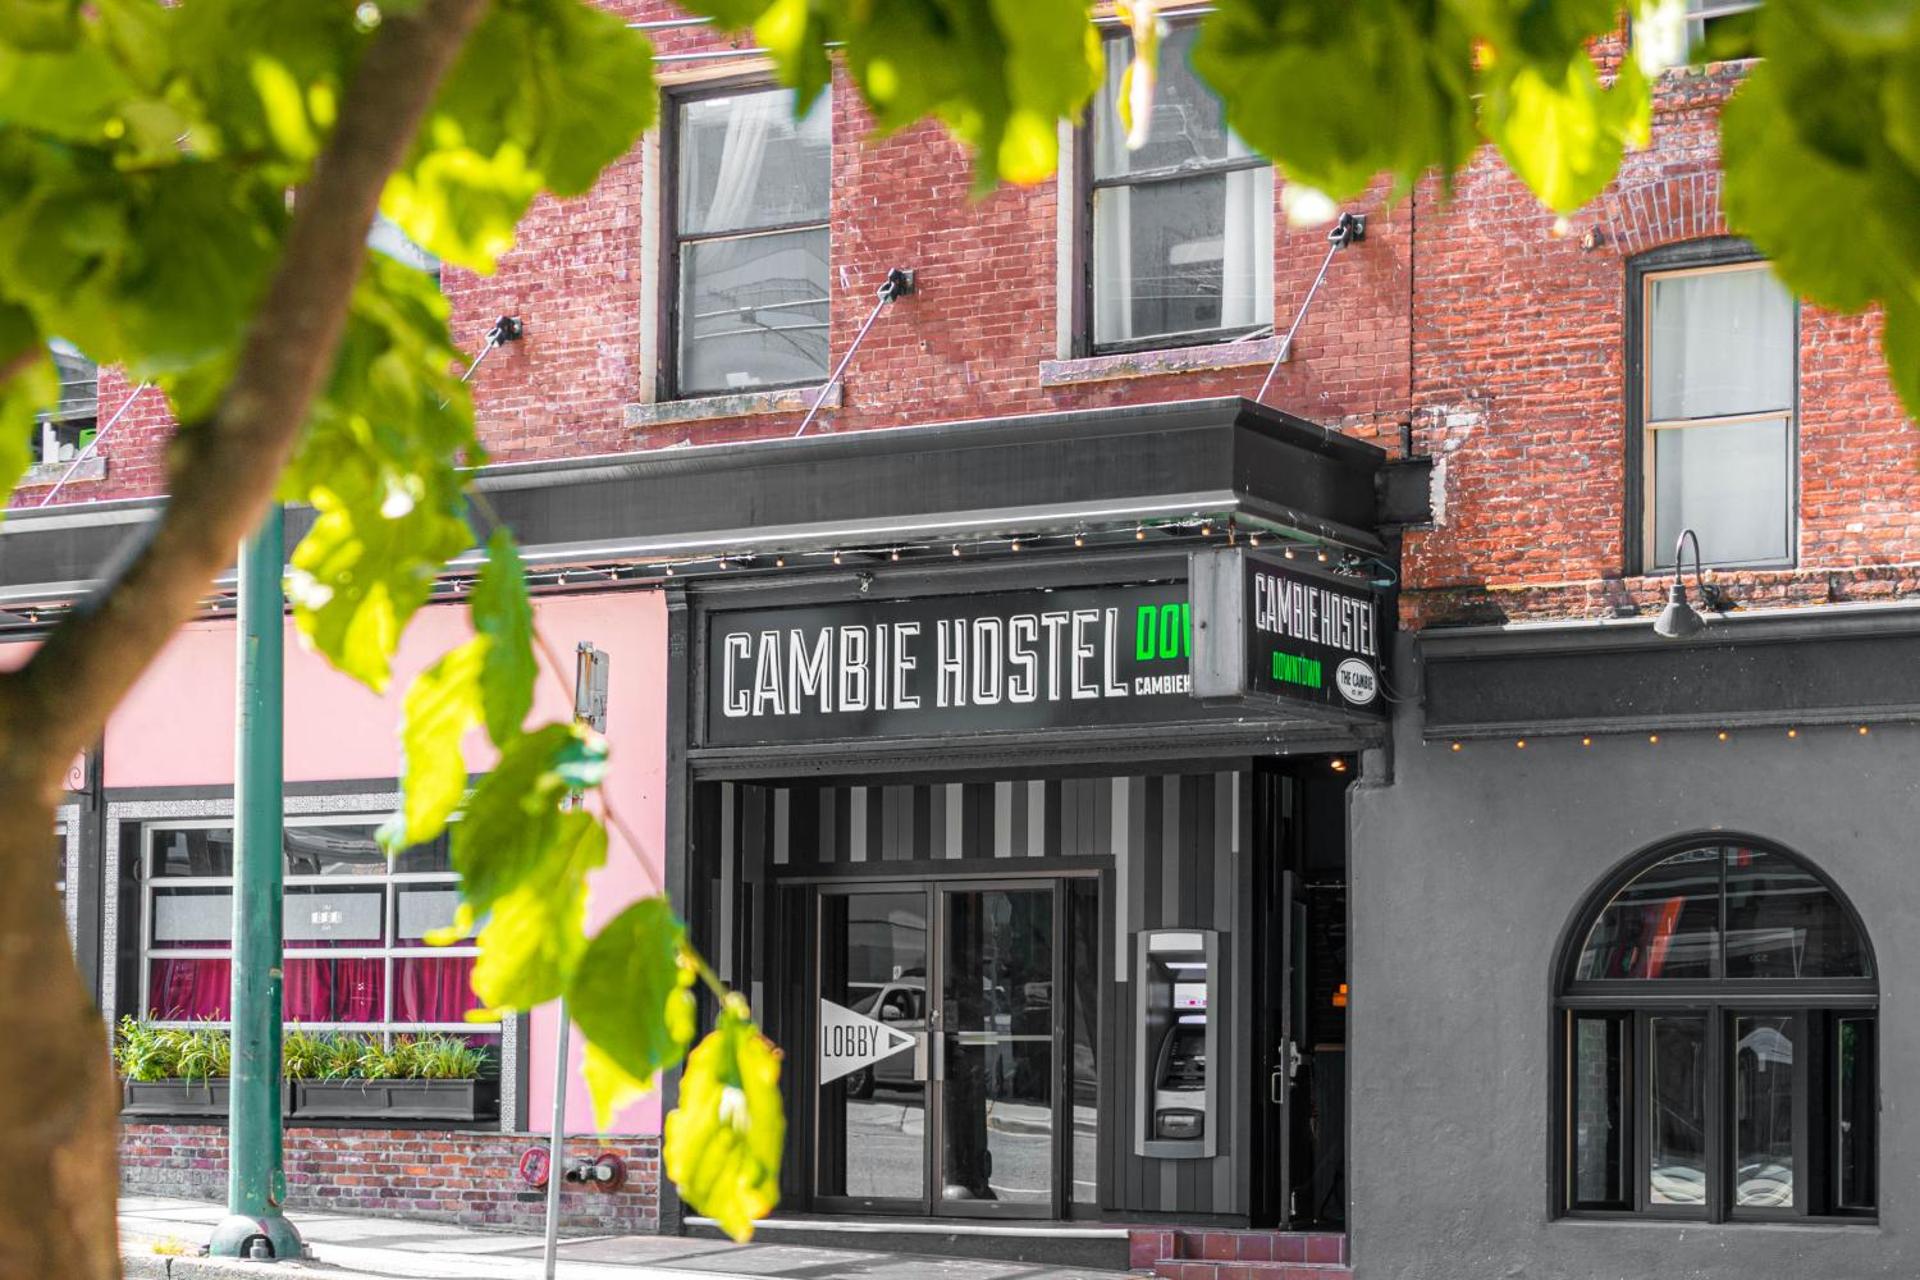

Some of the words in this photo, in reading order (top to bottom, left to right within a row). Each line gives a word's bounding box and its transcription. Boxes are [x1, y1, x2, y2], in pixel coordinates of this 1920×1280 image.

[1255, 572, 1319, 643] CAMBIE
[1320, 589, 1376, 656] HOSTEL
[723, 621, 921, 717] CAMBIE
[936, 607, 1128, 707] HOSTEL
[1273, 651, 1321, 689] DOWNTOWN
[1341, 670, 1351, 686] THE
[824, 1025, 878, 1057] LOBBY
